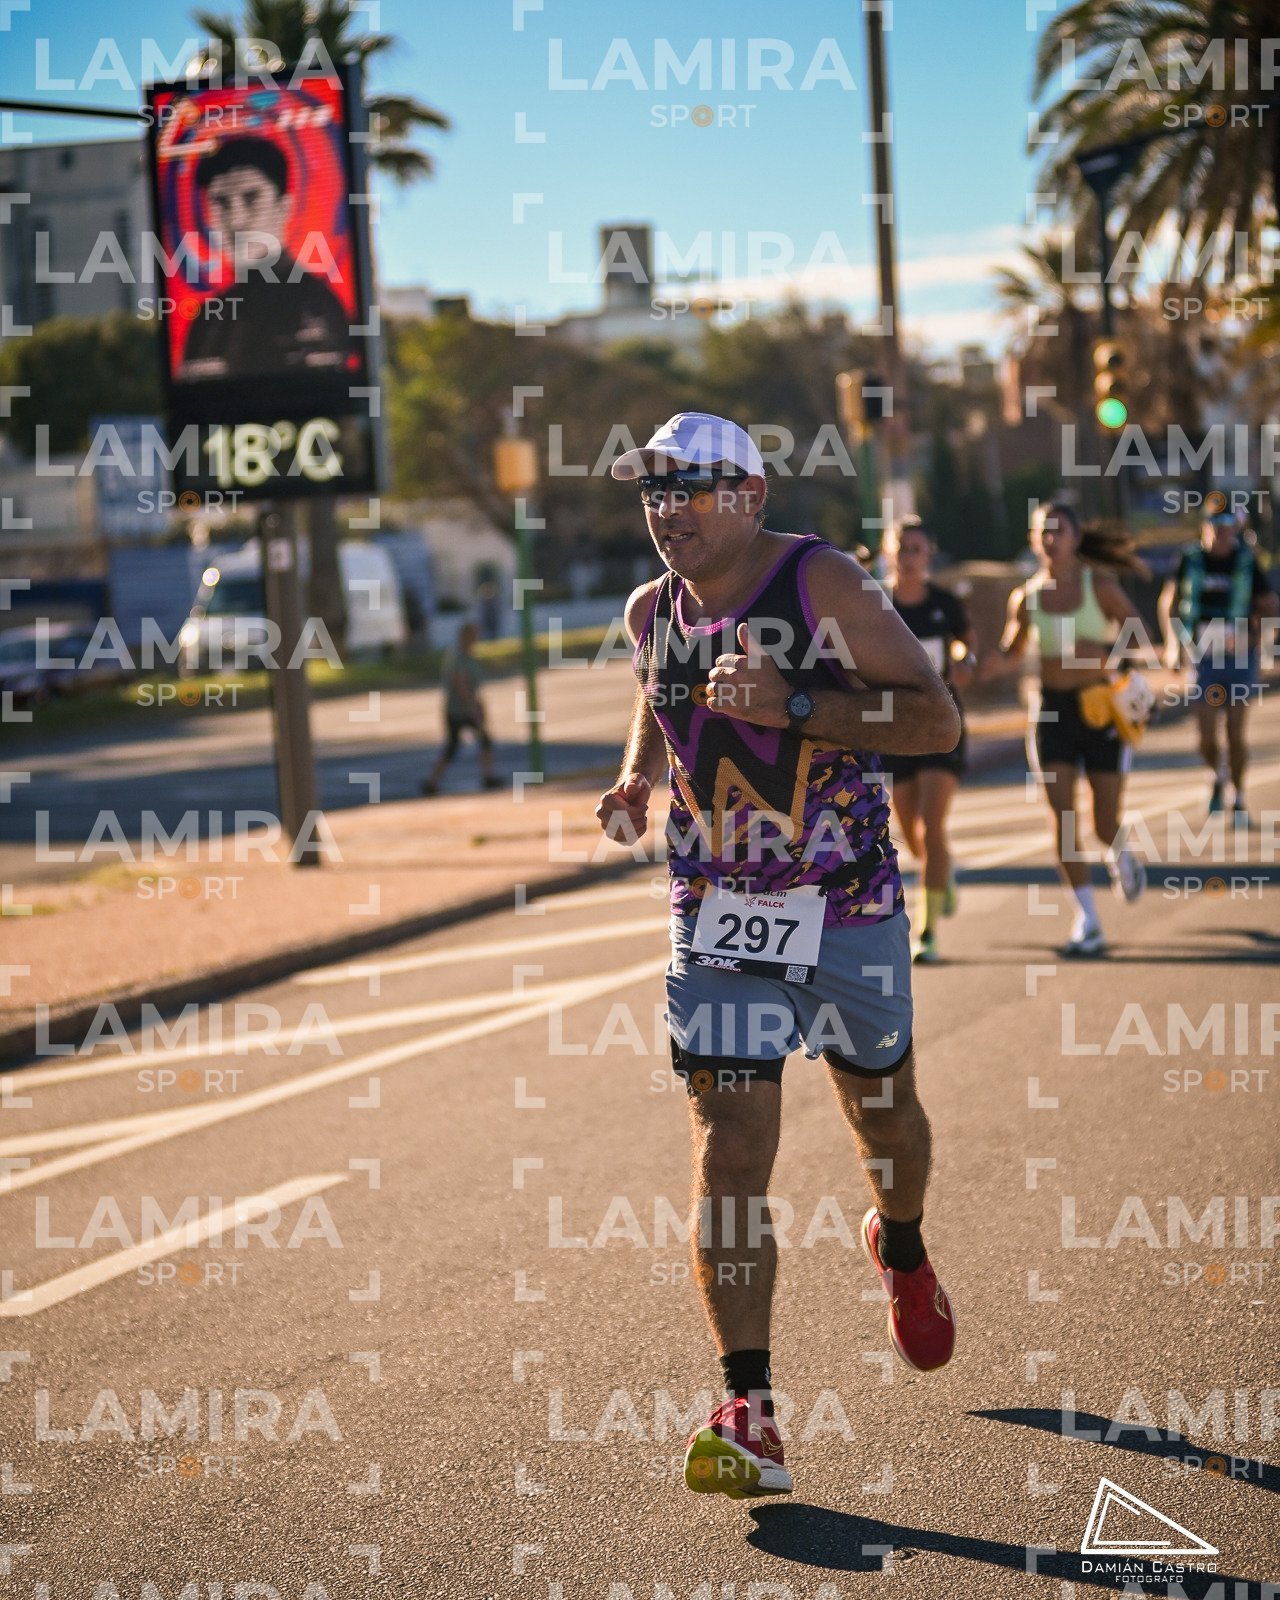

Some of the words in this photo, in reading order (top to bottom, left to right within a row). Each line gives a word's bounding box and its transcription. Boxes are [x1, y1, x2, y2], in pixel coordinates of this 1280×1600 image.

[757, 900, 785, 909] FALCK
[713, 912, 800, 956] 297
[695, 955, 740, 969] 30K
